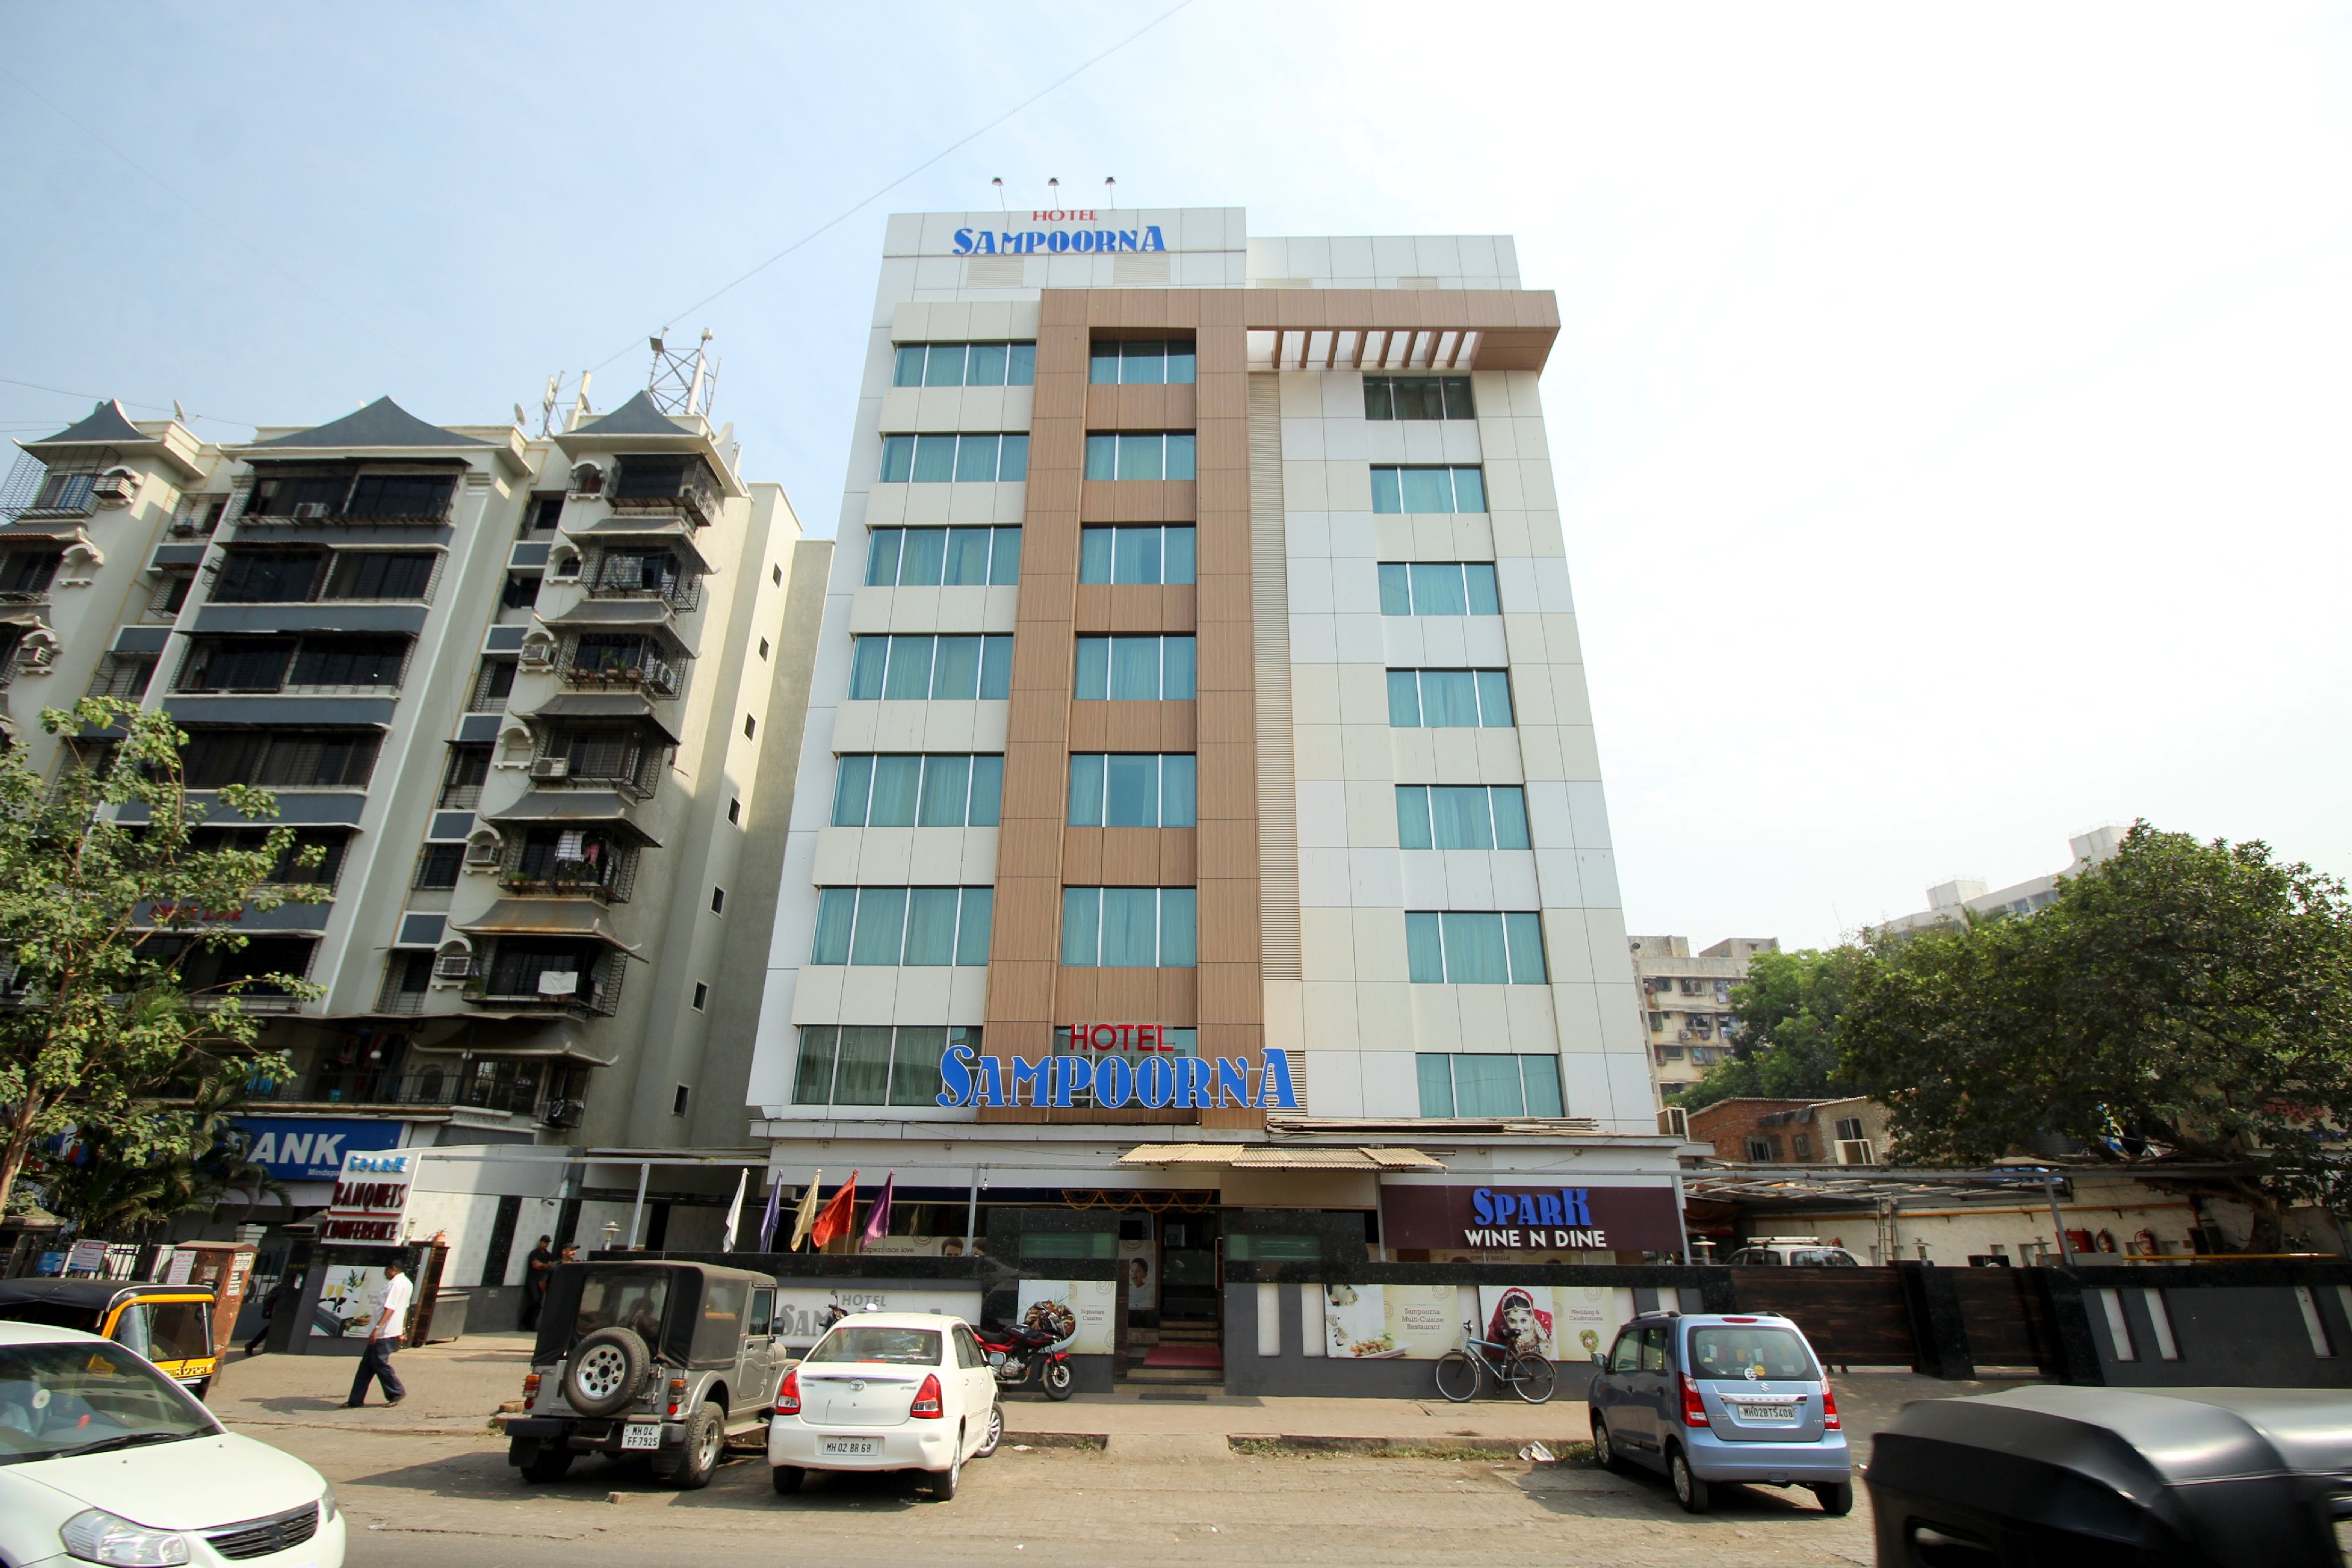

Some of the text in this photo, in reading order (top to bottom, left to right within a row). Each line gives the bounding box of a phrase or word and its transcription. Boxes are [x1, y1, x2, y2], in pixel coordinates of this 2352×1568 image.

[1032, 210, 1098, 222] HOTEL
[952, 226, 1166, 255] SAMPOORNA
[1070, 1024, 1174, 1051] HOTEL
[935, 1045, 1299, 1108] SAMPOORNA
[331, 1181, 408, 1211] BANQUETS
[1473, 1188, 1593, 1226] SPARK
[1464, 1230, 1607, 1248] WINE N DINE
[842, 1294, 887, 1307] HOTEL
